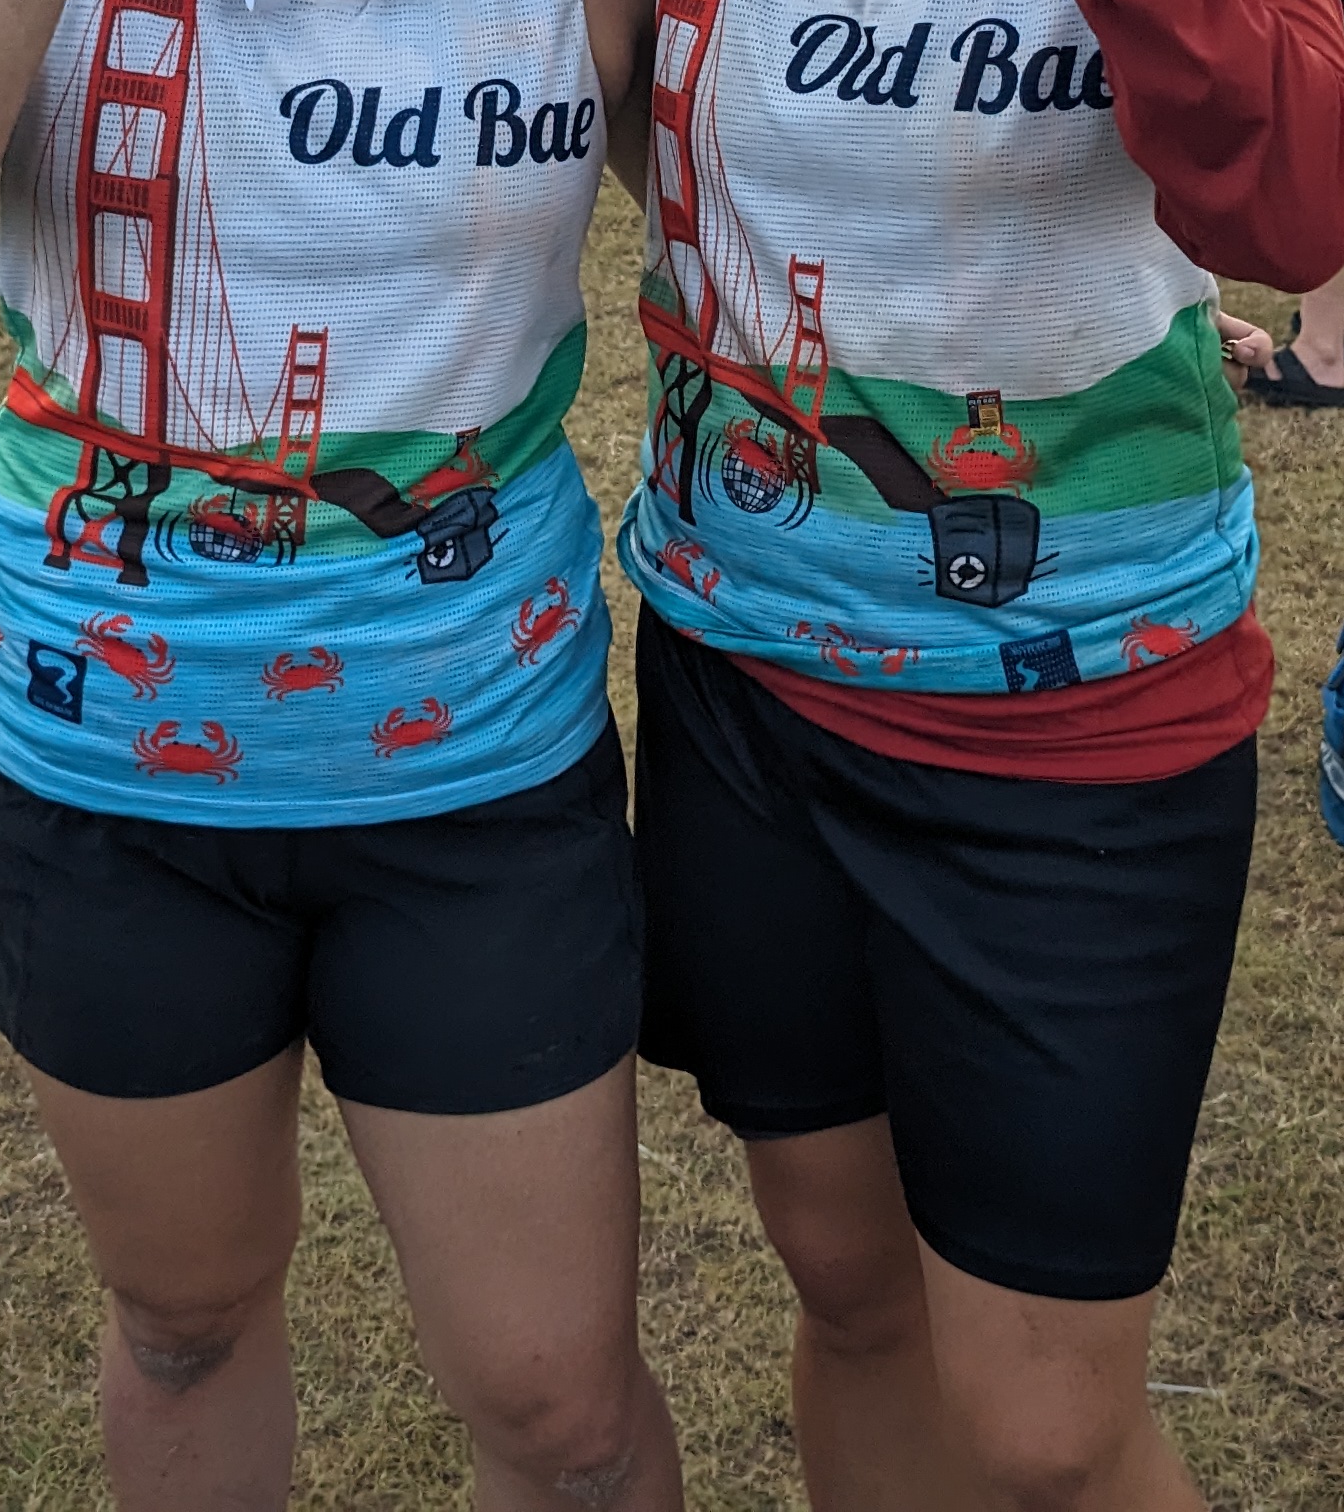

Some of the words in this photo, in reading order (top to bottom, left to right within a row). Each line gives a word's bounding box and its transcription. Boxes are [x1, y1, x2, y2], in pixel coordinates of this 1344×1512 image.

[785, 14, 933, 109] Old
[279, 78, 443, 168] Old
[463, 78, 595, 168] Bae
